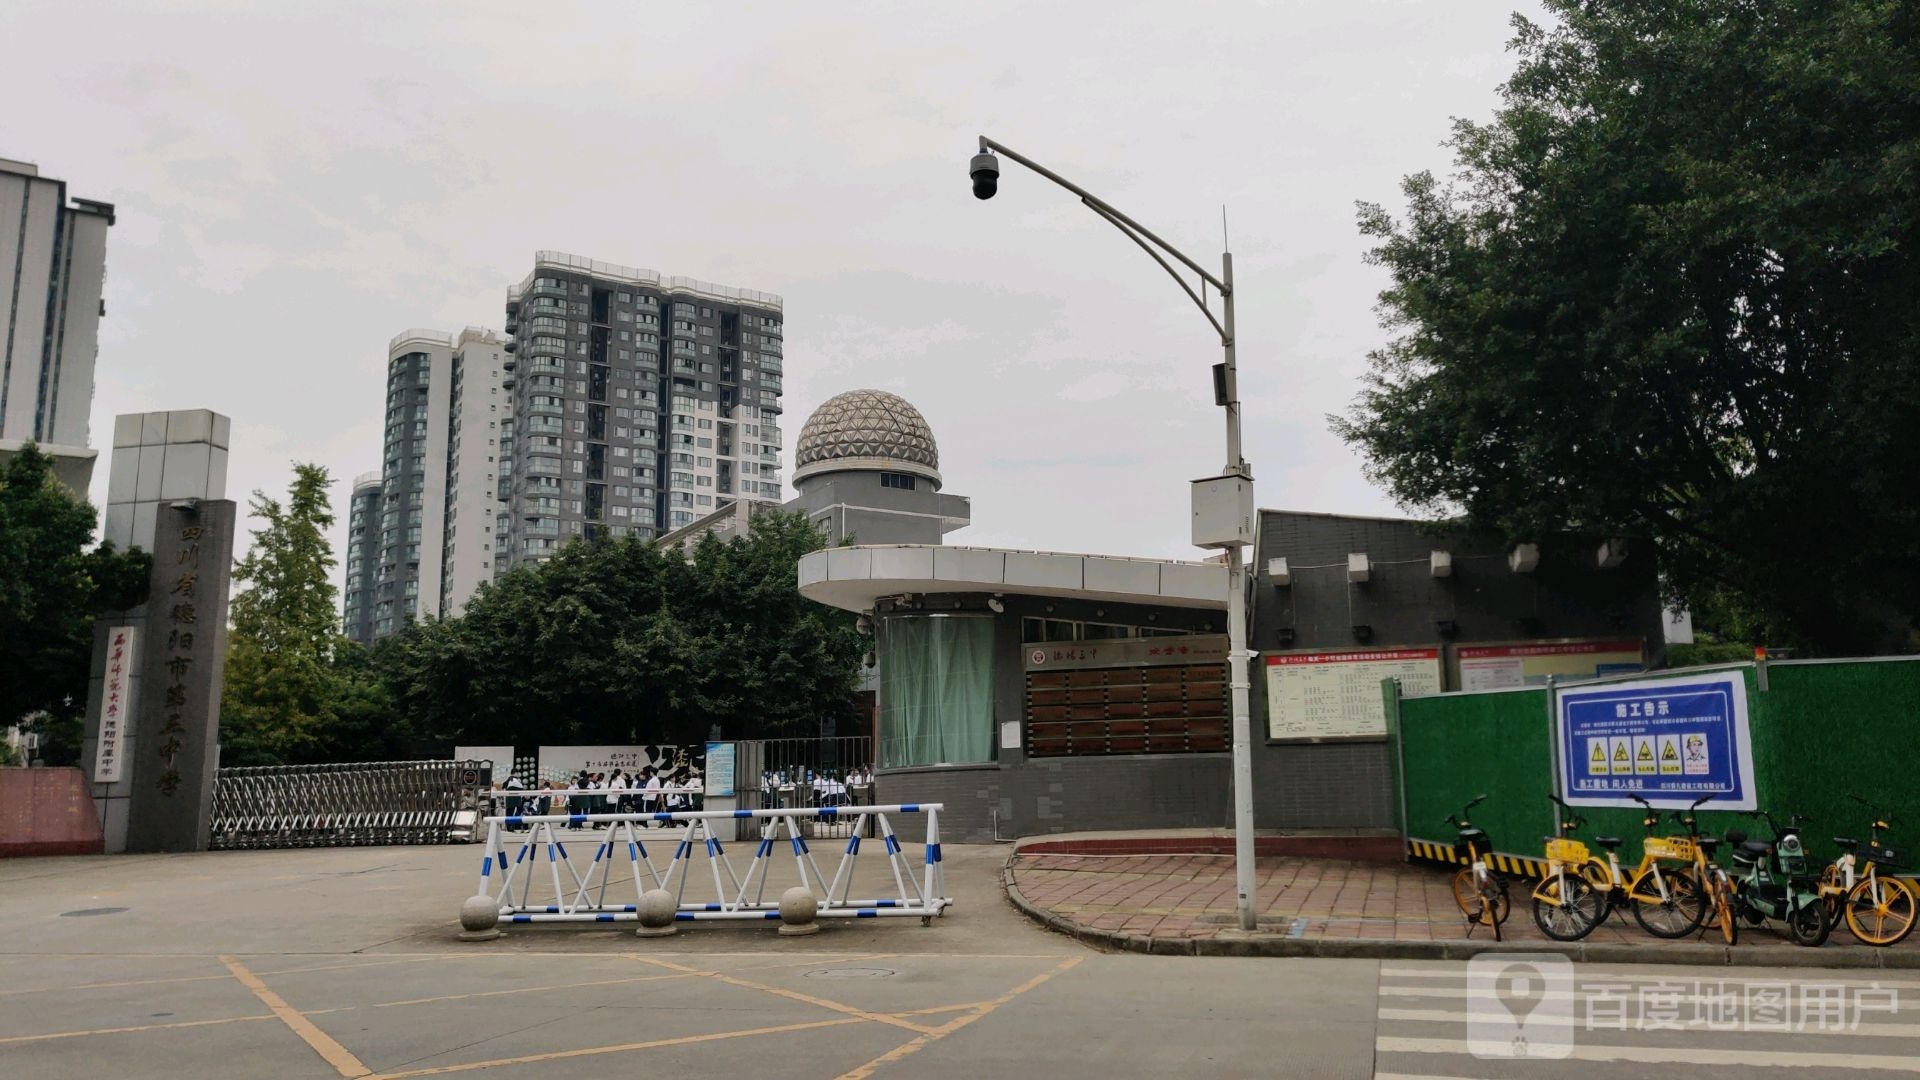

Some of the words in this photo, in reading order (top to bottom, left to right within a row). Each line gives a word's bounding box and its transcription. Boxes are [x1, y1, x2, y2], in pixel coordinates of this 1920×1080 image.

[156, 526, 204, 797] 四川省德阳市第三中学
[1616, 701, 1669, 717] 施工告示
